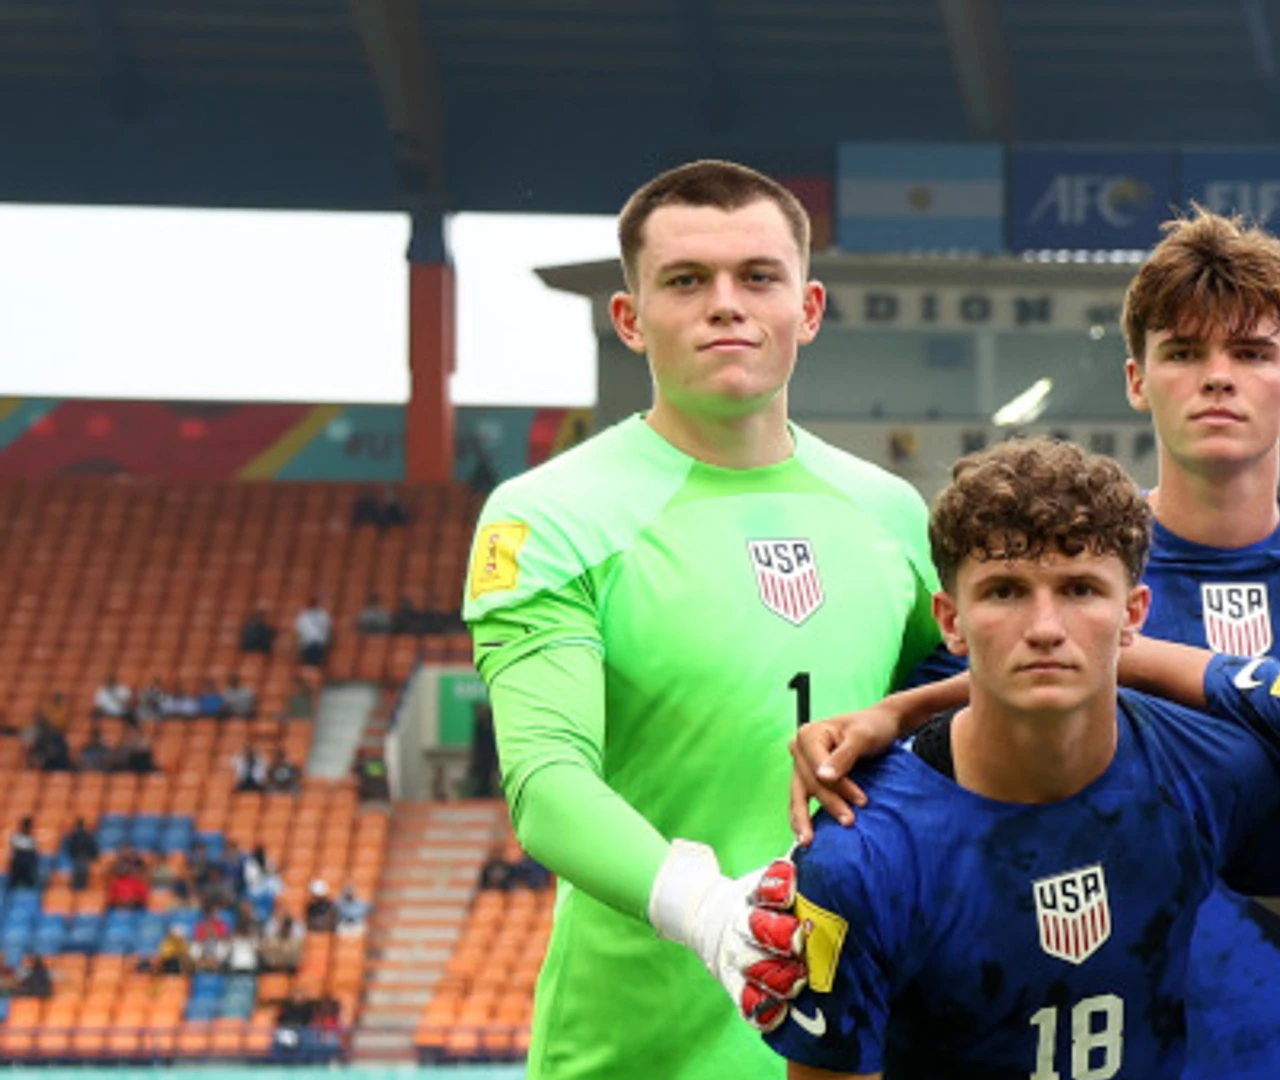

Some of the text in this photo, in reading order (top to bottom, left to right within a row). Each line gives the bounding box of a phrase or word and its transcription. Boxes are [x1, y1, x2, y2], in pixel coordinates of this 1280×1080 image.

[1026, 174, 1142, 227] AFC
[753, 543, 810, 574] USA
[1206, 588, 1263, 619] USA
[788, 672, 811, 728] 1
[1039, 873, 1102, 914] USA
